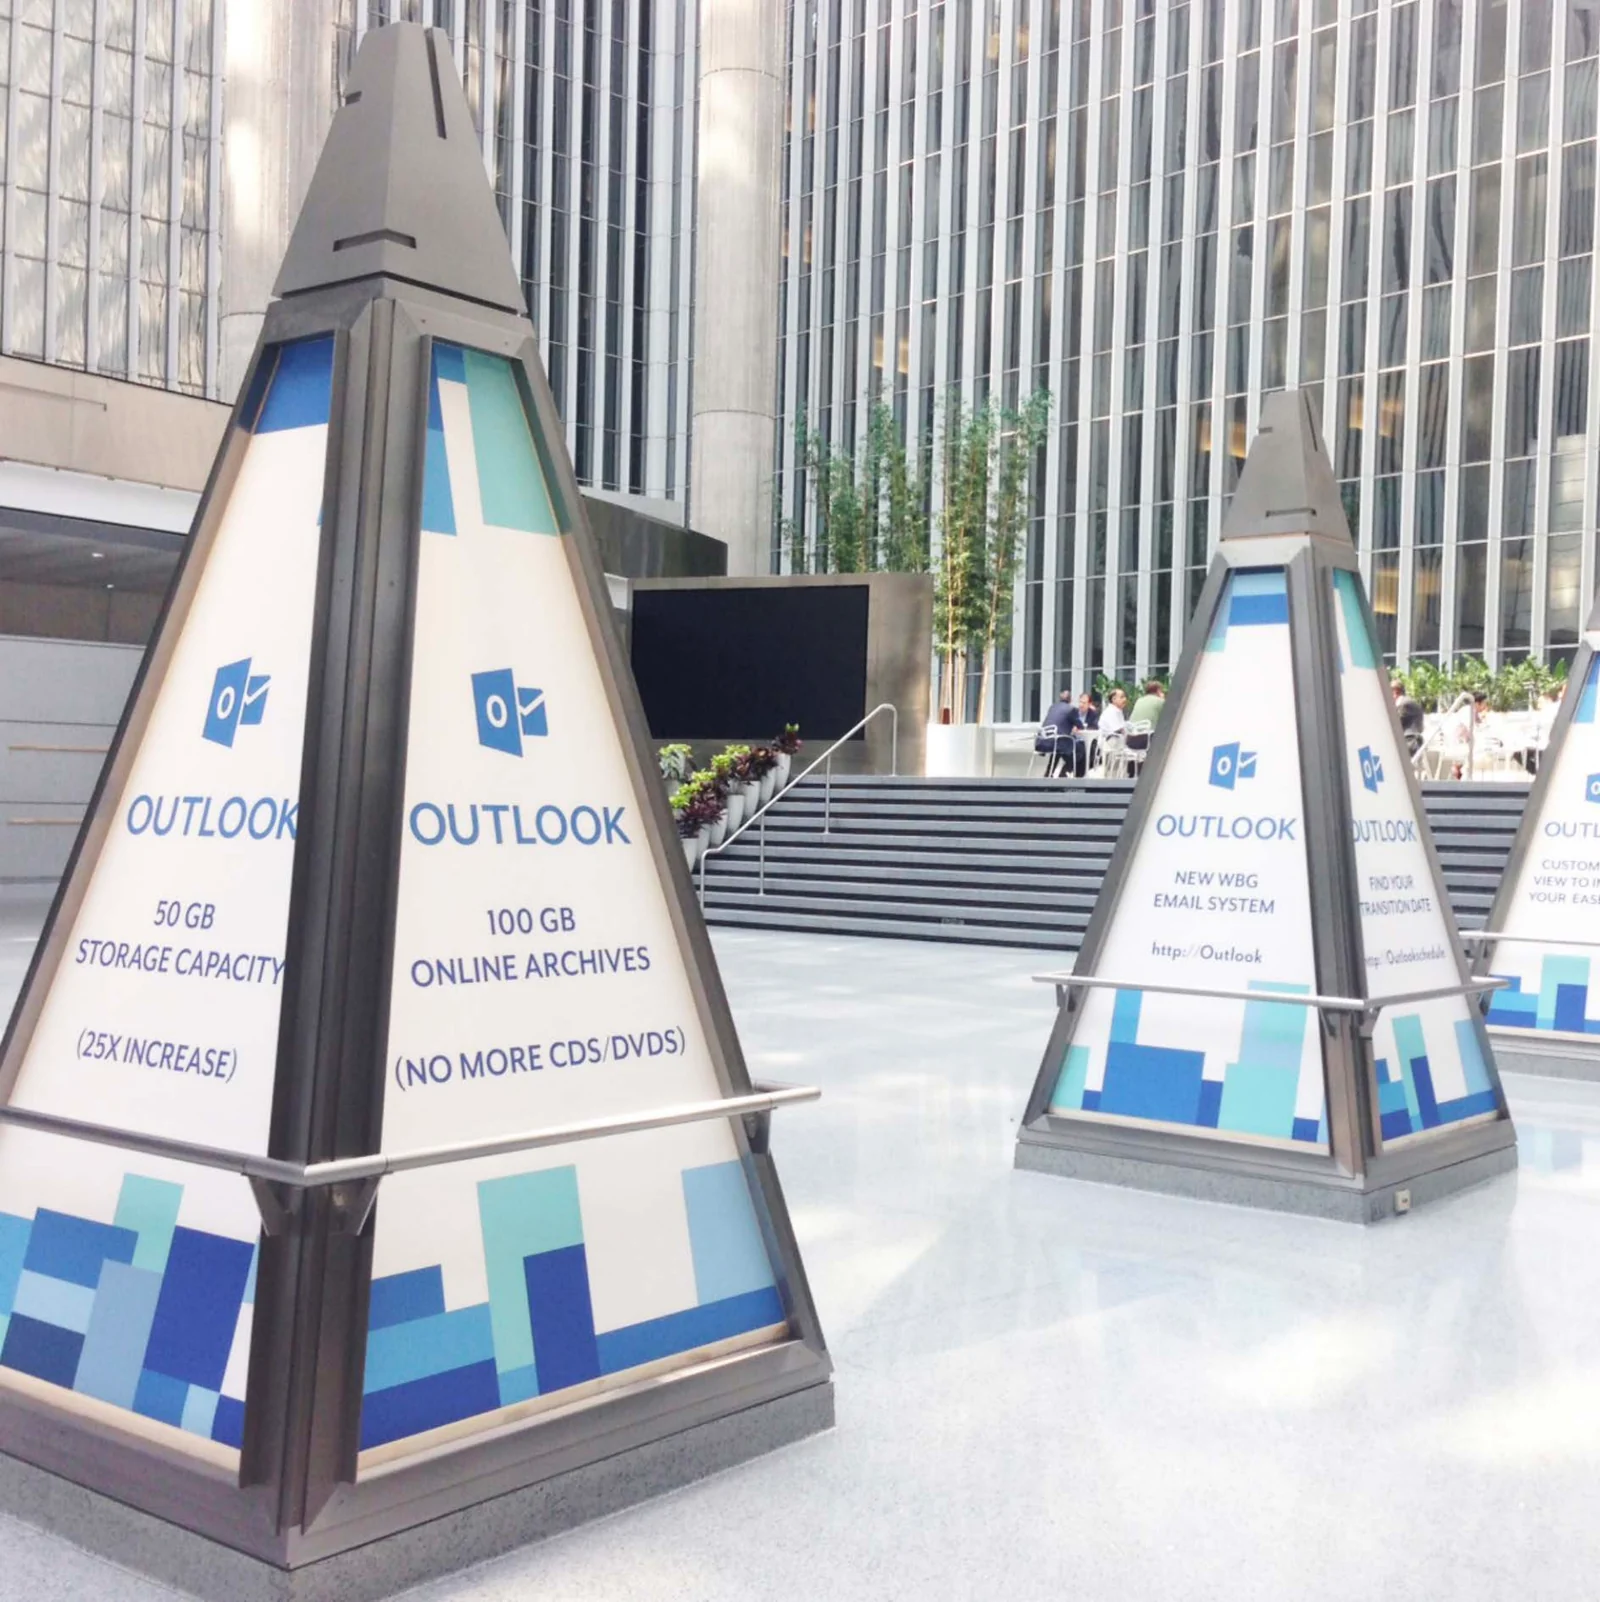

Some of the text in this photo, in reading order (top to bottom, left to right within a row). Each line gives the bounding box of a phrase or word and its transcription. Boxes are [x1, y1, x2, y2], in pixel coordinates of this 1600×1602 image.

[127, 794, 298, 840] OUTLOOK
[409, 802, 631, 846] OUTLOOK
[1156, 814, 1297, 841] OUTLOOK
[1175, 871, 1259, 889] NEW WBG
[1534, 876, 1567, 887] VIEW
[1572, 877, 1589, 888] TO
[1154, 893, 1275, 914] EMAIL SYSTEM
[1529, 892, 1566, 903] YOUR
[153, 900, 216, 930] 50 GB
[487, 907, 576, 936] 100 GB
[76, 938, 285, 985] STORAGE CAPACITY
[411, 946, 651, 988] ONLINE ARCHIVES
[1151, 941, 1262, 964] http://Outlook
[77, 1028, 238, 1084] (25X INCREASE)
[395, 1026, 686, 1091] (NO MORE CDS/DVDS)
